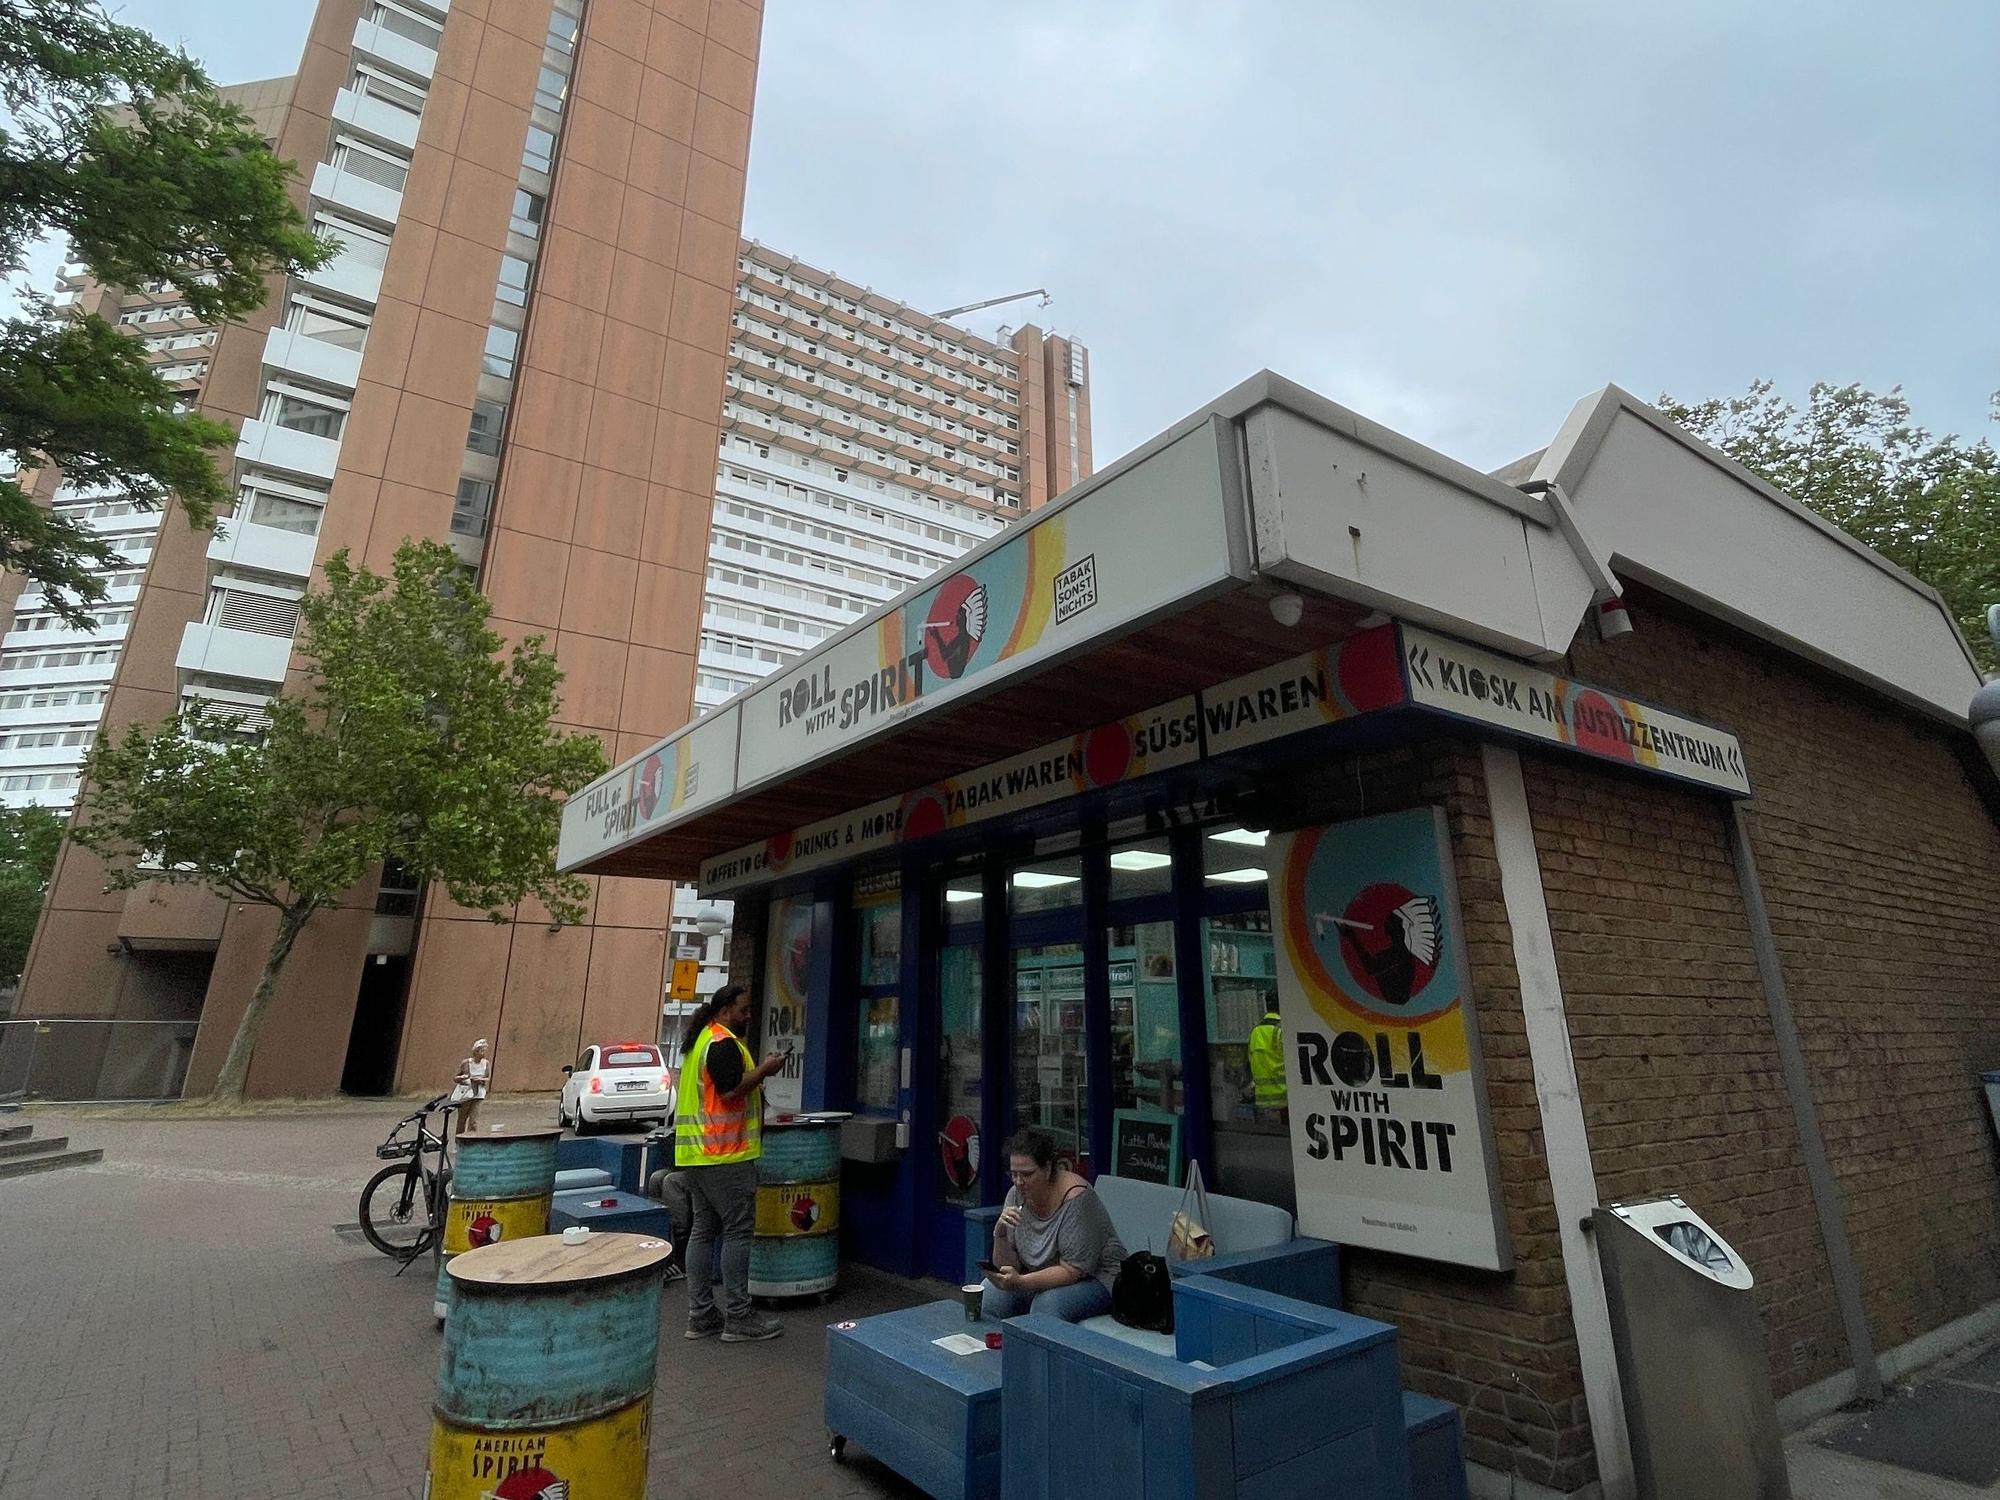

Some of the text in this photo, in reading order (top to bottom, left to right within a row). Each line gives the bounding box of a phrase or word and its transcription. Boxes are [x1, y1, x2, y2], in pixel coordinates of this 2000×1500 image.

[1057, 561, 1091, 590] TABAK
[1058, 576, 1091, 604] SONST
[1059, 590, 1093, 618] NICHTS
[779, 664, 836, 728] ROLL
[839, 650, 927, 729] SPIRIT
[1438, 657, 1522, 712] KIOSK
[1528, 687, 1568, 726] AM
[805, 706, 835, 735] WITH
[585, 786, 609, 822] FULL
[602, 797, 640, 839] SPIRIT
[795, 810, 903, 859] DRINKS & MORE
[706, 858, 737, 886] COFFEE
[739, 854, 752, 875] TO
[1297, 1031, 1443, 1090] ROLL
[1331, 1089, 1390, 1114] WITH
[1305, 1113, 1457, 1173] SPIRIT
[474, 1437, 546, 1453] AMERICAN
[472, 1452, 545, 1480] SPIRIT
